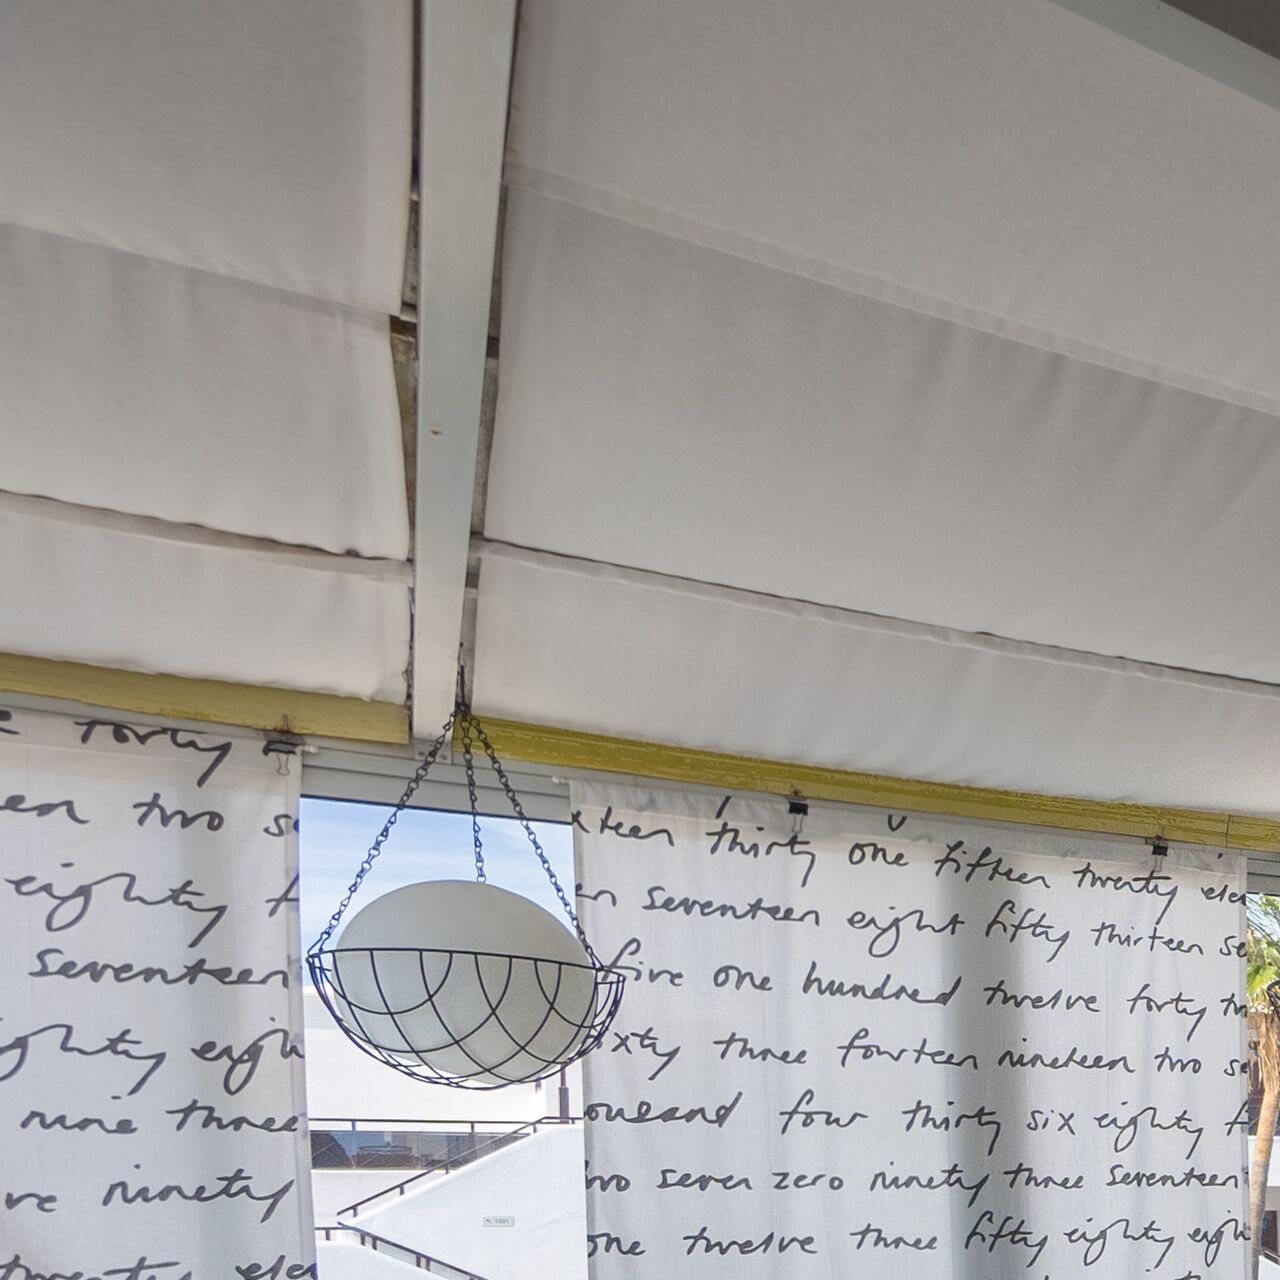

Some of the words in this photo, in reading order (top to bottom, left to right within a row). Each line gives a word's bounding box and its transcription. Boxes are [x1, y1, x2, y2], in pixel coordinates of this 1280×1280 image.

[132, 793, 224, 831] two
[705, 822, 816, 888] thirty
[849, 843, 909, 867] one
[934, 841, 1051, 888] fifteen
[1073, 862, 1178, 925] twenty
[4, 862, 228, 948] eighty
[642, 886, 820, 926] seventeen
[846, 906, 965, 958] eight
[985, 900, 1070, 963] fifty
[1091, 922, 1203, 955] thirteen
[602, 937, 683, 987] five
[713, 965, 773, 991] one
[802, 961, 962, 1006] hundred
[983, 980, 1100, 1012] twelve
[1126, 983, 1207, 1042] forty
[713, 1032, 807, 1064] three
[837, 1028, 978, 1070] fourteen
[998, 1038, 1136, 1073] nineteen
[1154, 1047, 1202, 1074] two
[20, 1096, 138, 1134] nine
[165, 1099, 299, 1132] three
[779, 1089, 869, 1135] four
[901, 1100, 1001, 1156] thirty
[1027, 1110, 1075, 1136] six
[1093, 1101, 1204, 1160] eighty
[102, 1164, 294, 1223] ninety
[656, 1169, 753, 1191] seven
[772, 1172, 843, 1190] zero
[870, 1161, 990, 1208] ninety
[1003, 1163, 1083, 1189] three
[1106, 1164, 1238, 1189] seventeen
[683, 1226, 818, 1255] twelve
[850, 1223, 937, 1250] three
[965, 1210, 1048, 1268] fifty
[1063, 1218, 1175, 1269] eighty
